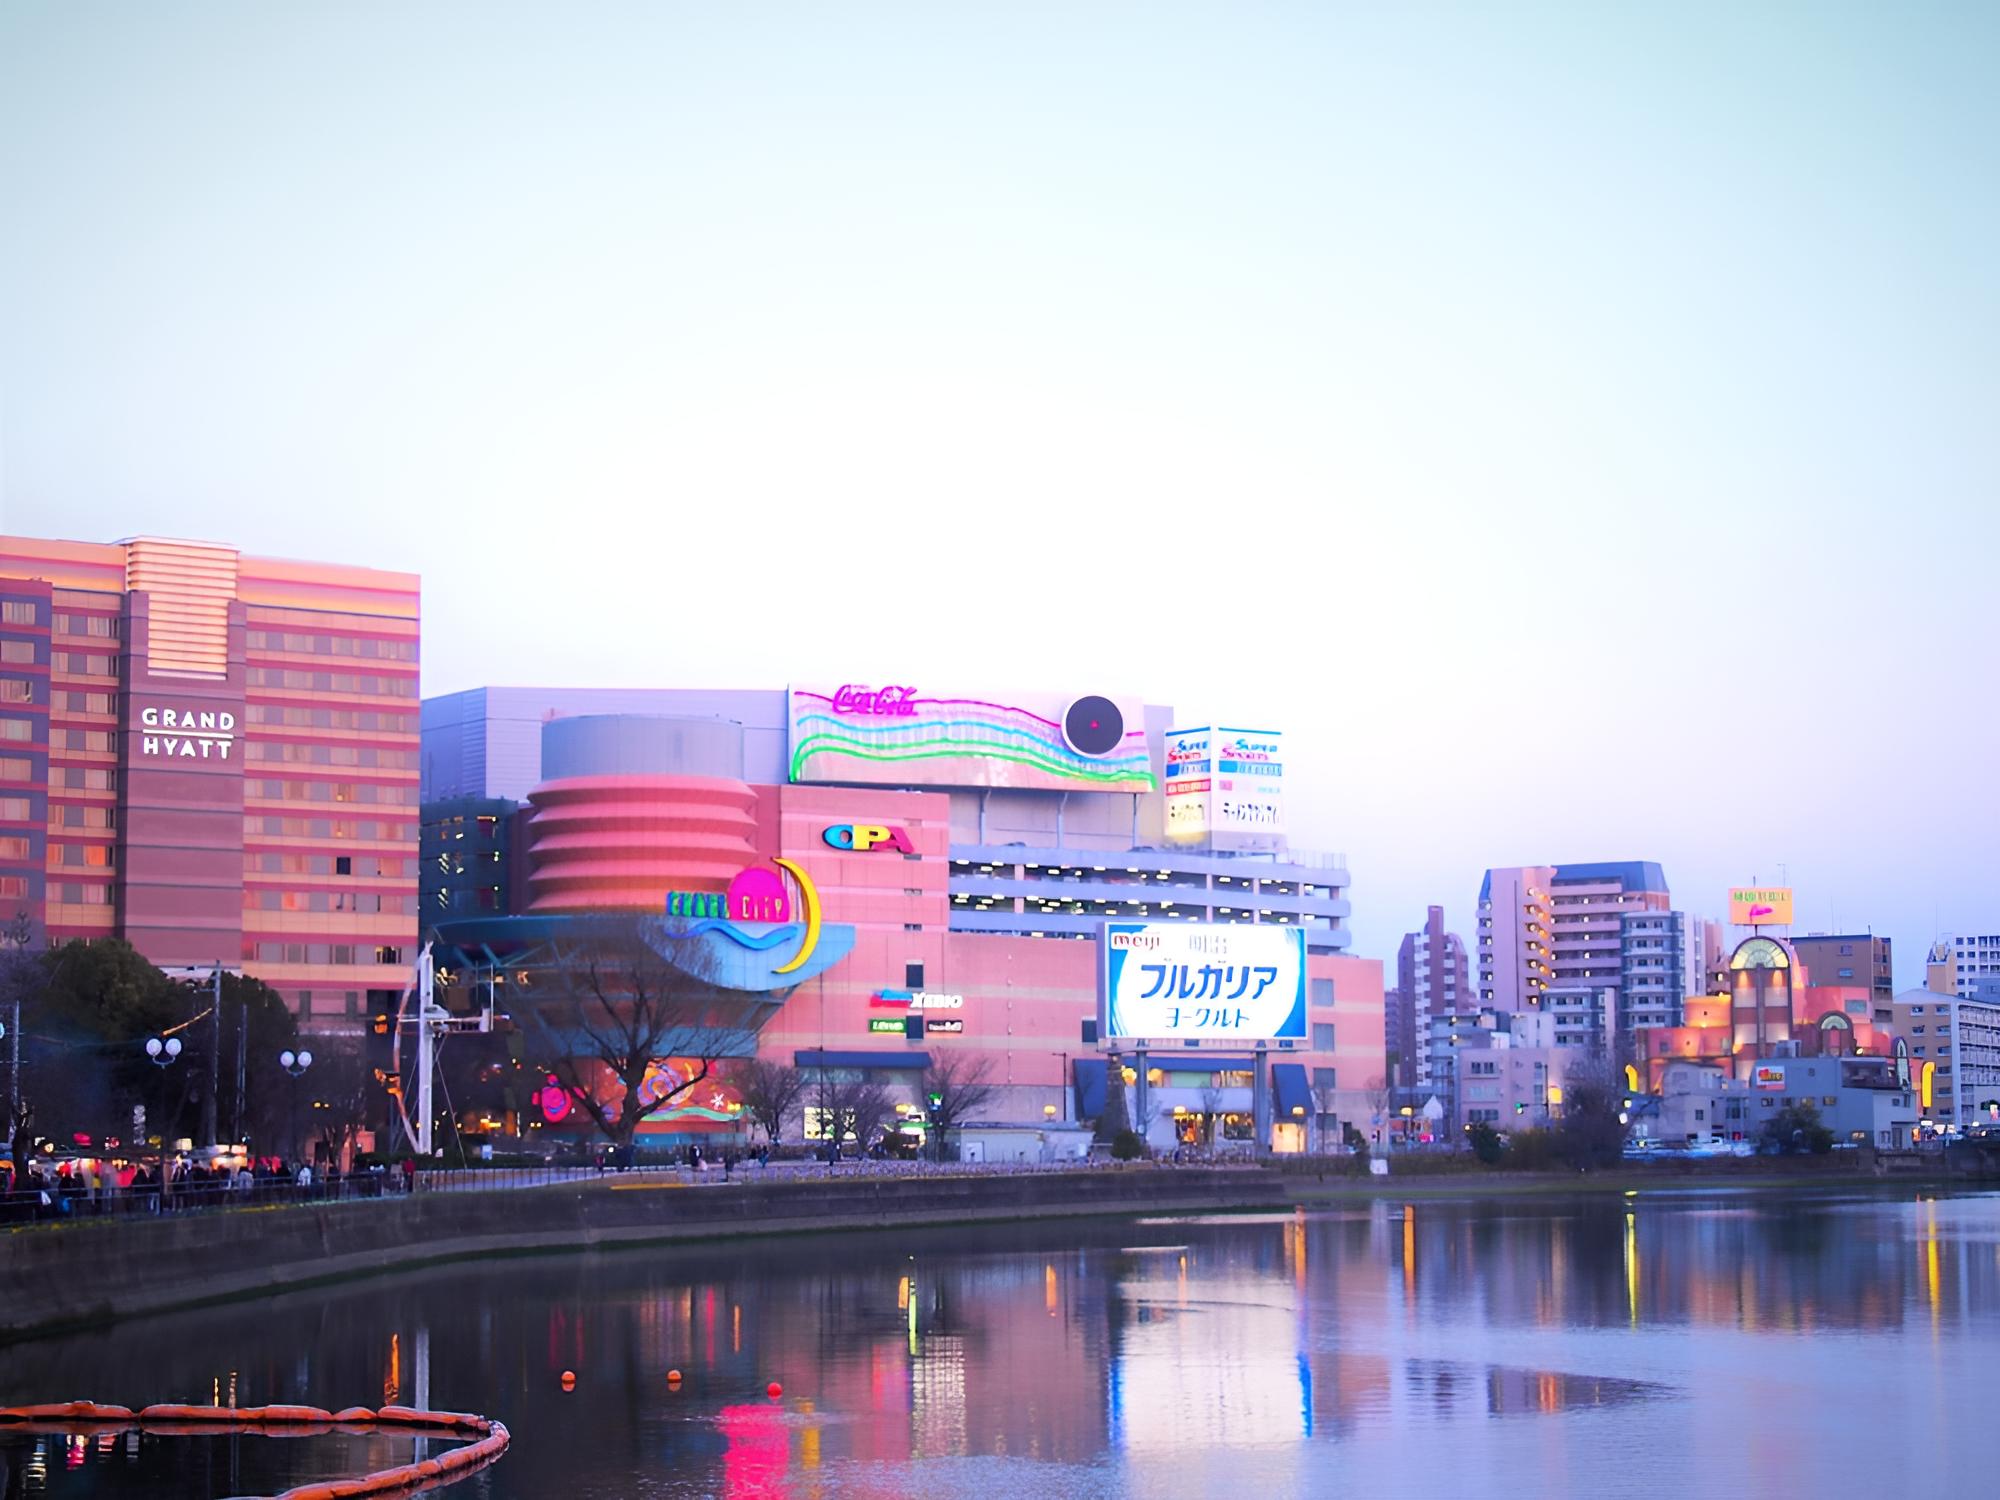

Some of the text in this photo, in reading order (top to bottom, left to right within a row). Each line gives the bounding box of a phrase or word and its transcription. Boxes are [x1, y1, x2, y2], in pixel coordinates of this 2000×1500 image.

[142, 708, 234, 730] GRAND
[143, 737, 232, 759] HYATT
[822, 824, 915, 854] OPA
[1114, 935, 1160, 950] meiji
